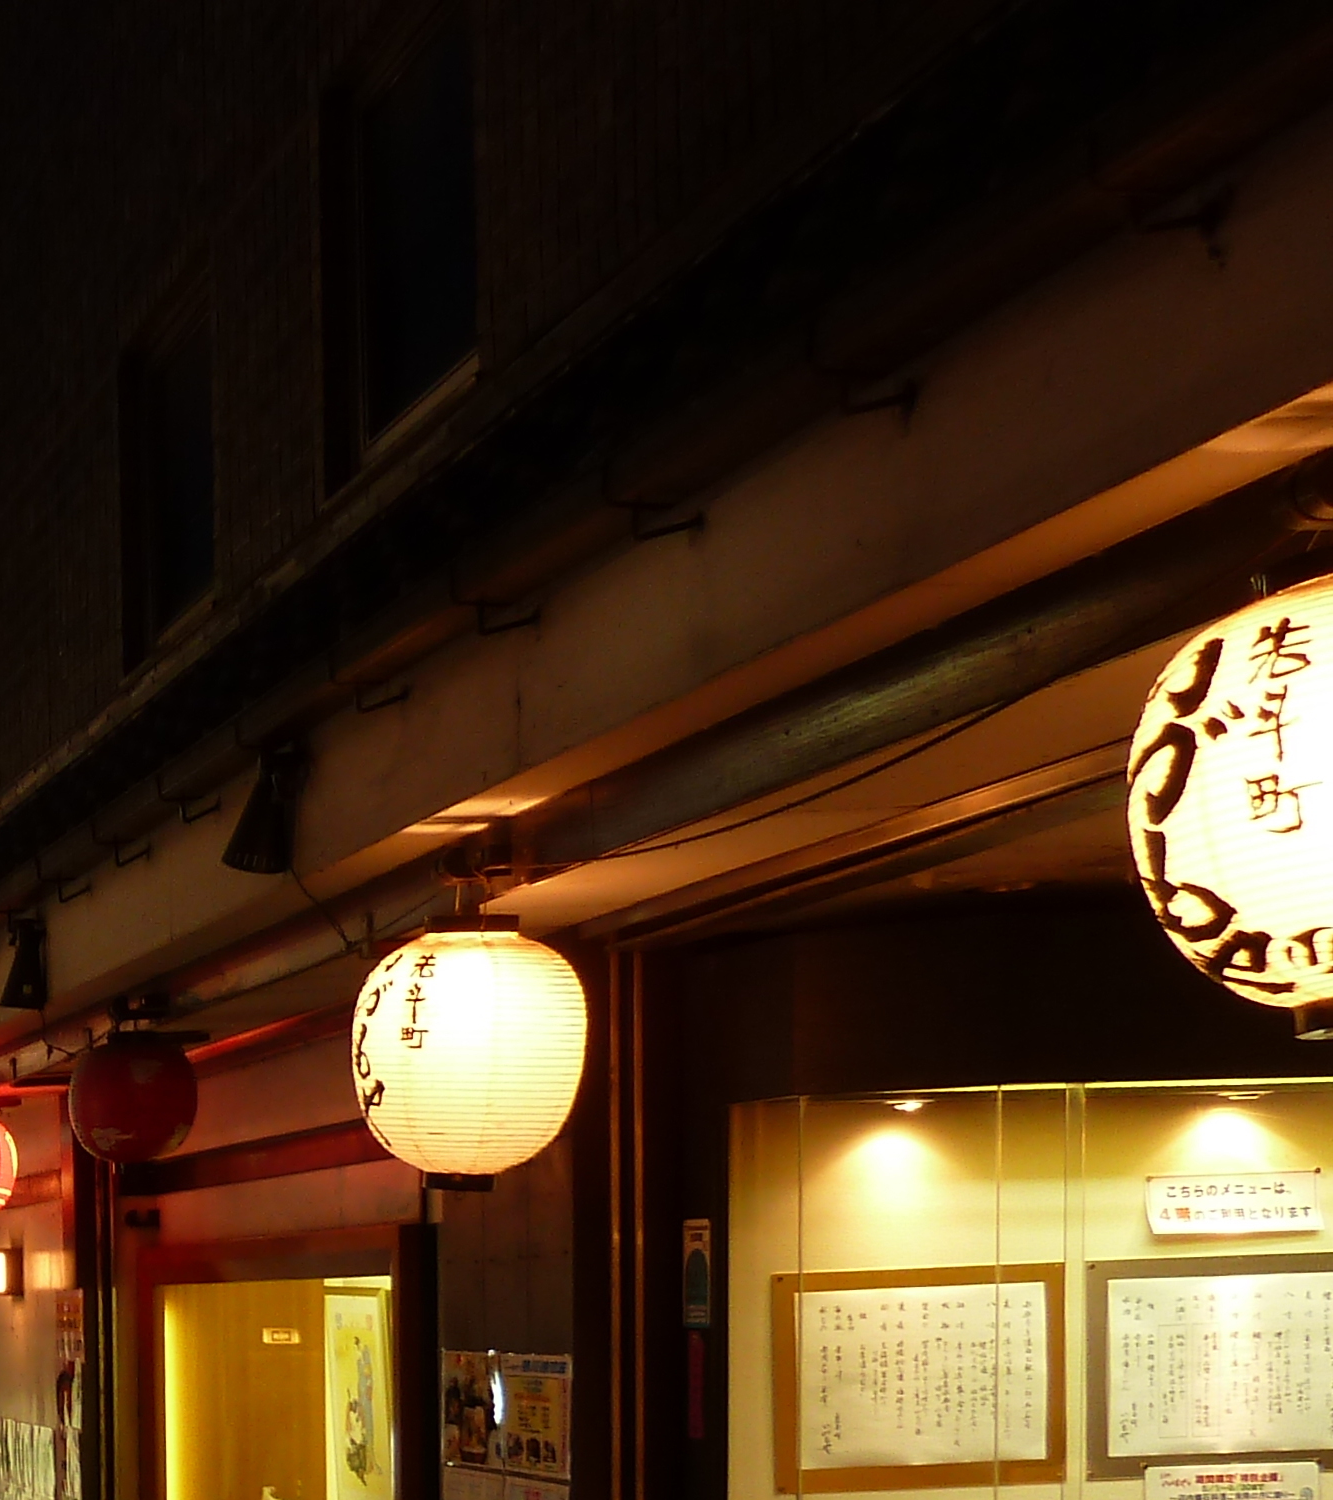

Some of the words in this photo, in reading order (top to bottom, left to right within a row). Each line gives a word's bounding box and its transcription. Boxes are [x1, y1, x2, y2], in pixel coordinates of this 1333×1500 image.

[1247, 617, 1323, 833] 先斗町
[399, 953, 437, 1049] 先斗町
[1166, 1181, 1292, 1199] こちらのメニューは、
